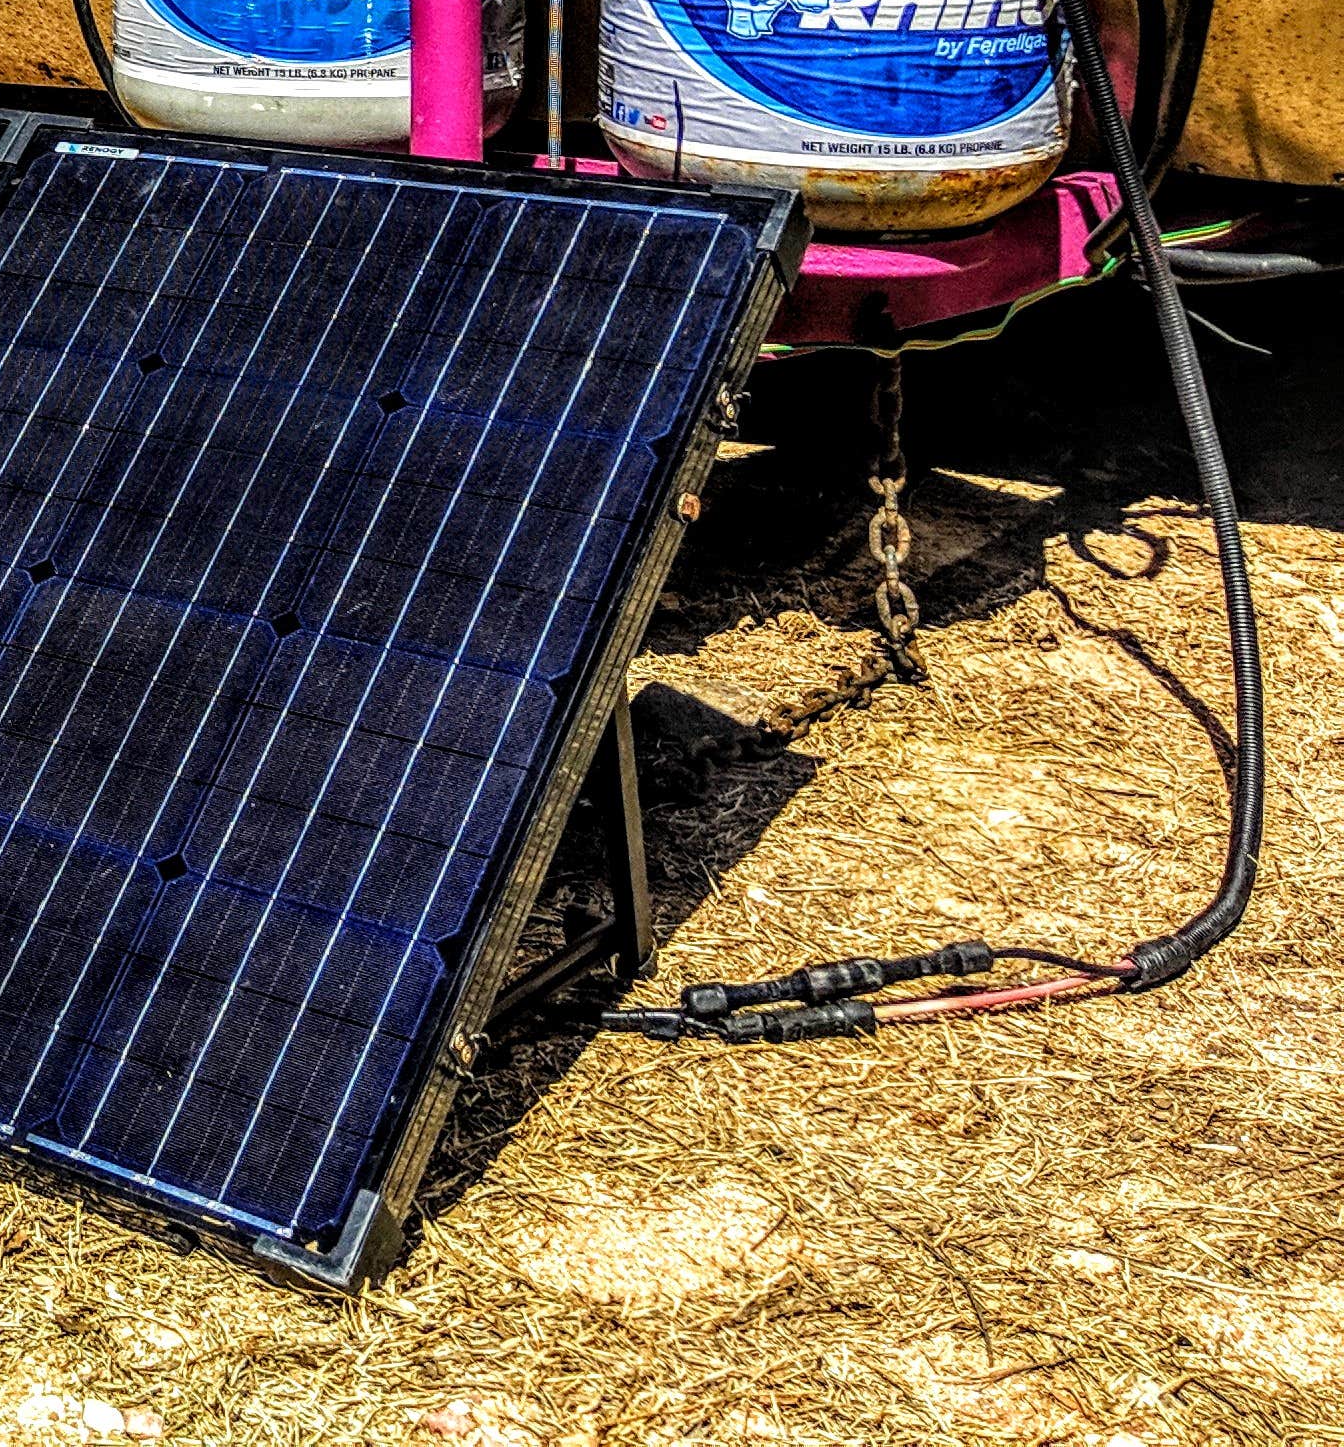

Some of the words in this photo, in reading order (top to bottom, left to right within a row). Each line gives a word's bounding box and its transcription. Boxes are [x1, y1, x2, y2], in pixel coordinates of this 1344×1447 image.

[935, 37, 964, 60] by
[213, 65, 230, 76] NET
[233, 66, 271, 77] WEIGHT
[274, 68, 287, 78] 15
[330, 68, 348, 79] KG)
[350, 67, 398, 79] PROPANE
[81, 145, 125, 154] RENOGY
[801, 140, 825, 152] NET
[827, 141, 874, 155] WEIGHT
[877, 143, 892, 155] 15
[894, 144, 912, 155] LB.
[914, 143, 936, 157] (6.8
[938, 142, 957, 156] KG)
[959, 140, 1005, 153] PROPANE
